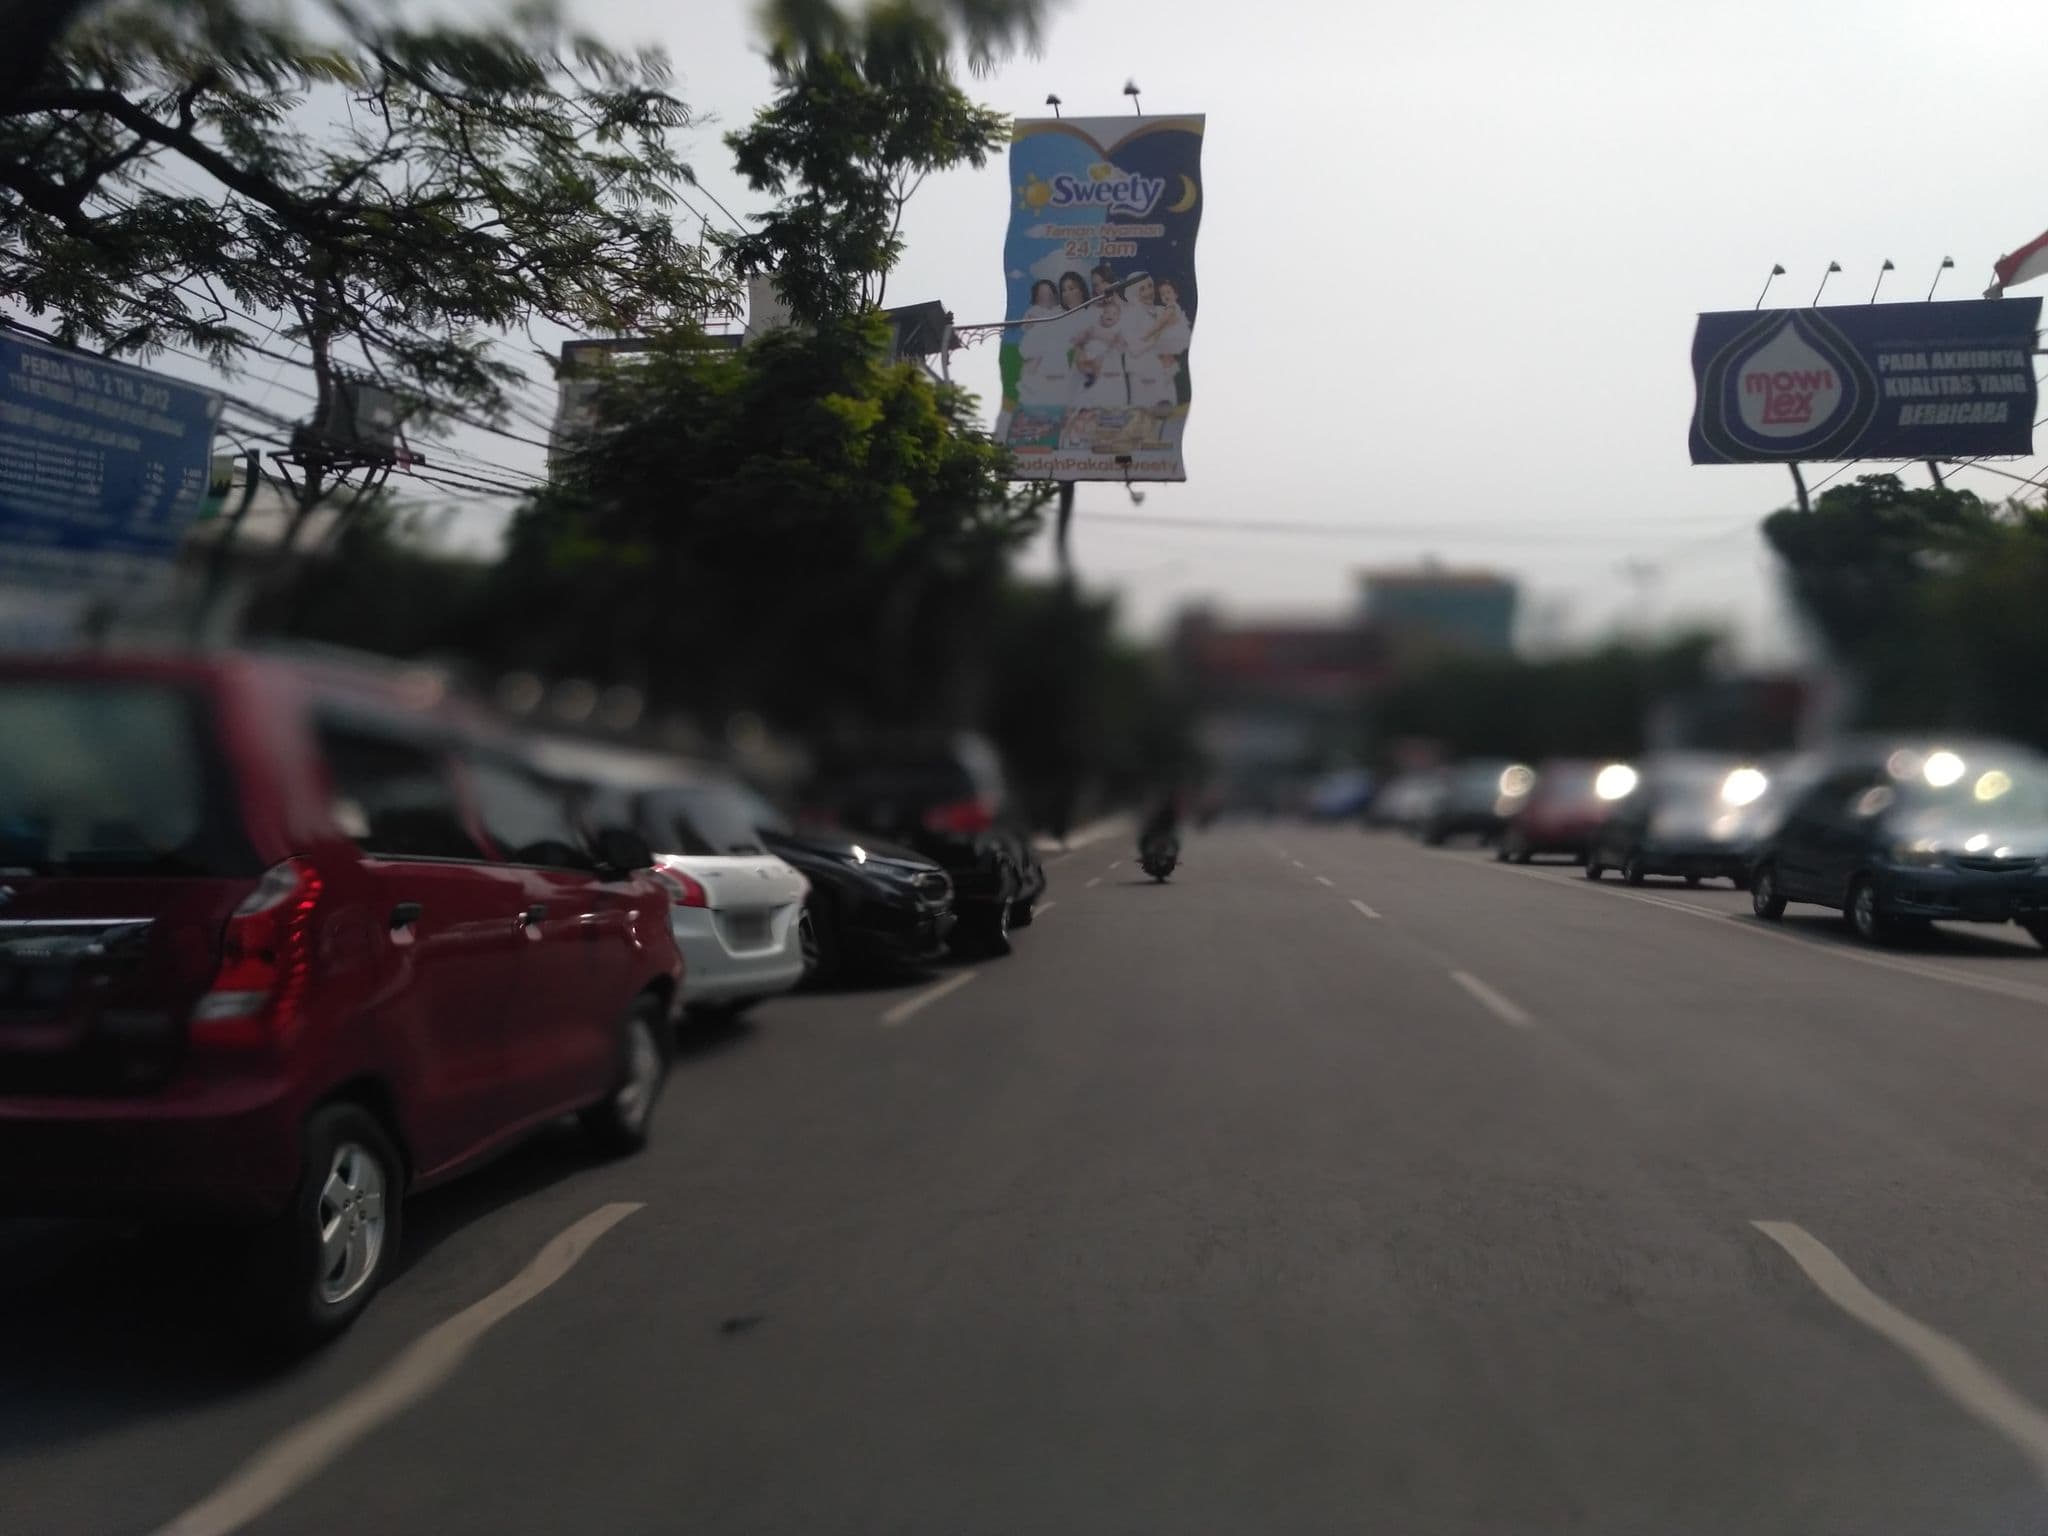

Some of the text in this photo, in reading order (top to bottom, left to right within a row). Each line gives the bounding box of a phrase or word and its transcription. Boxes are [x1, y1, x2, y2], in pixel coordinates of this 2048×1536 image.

[1052, 174, 1163, 212] Sweety
[1066, 240, 1137, 256] 24 Jam
